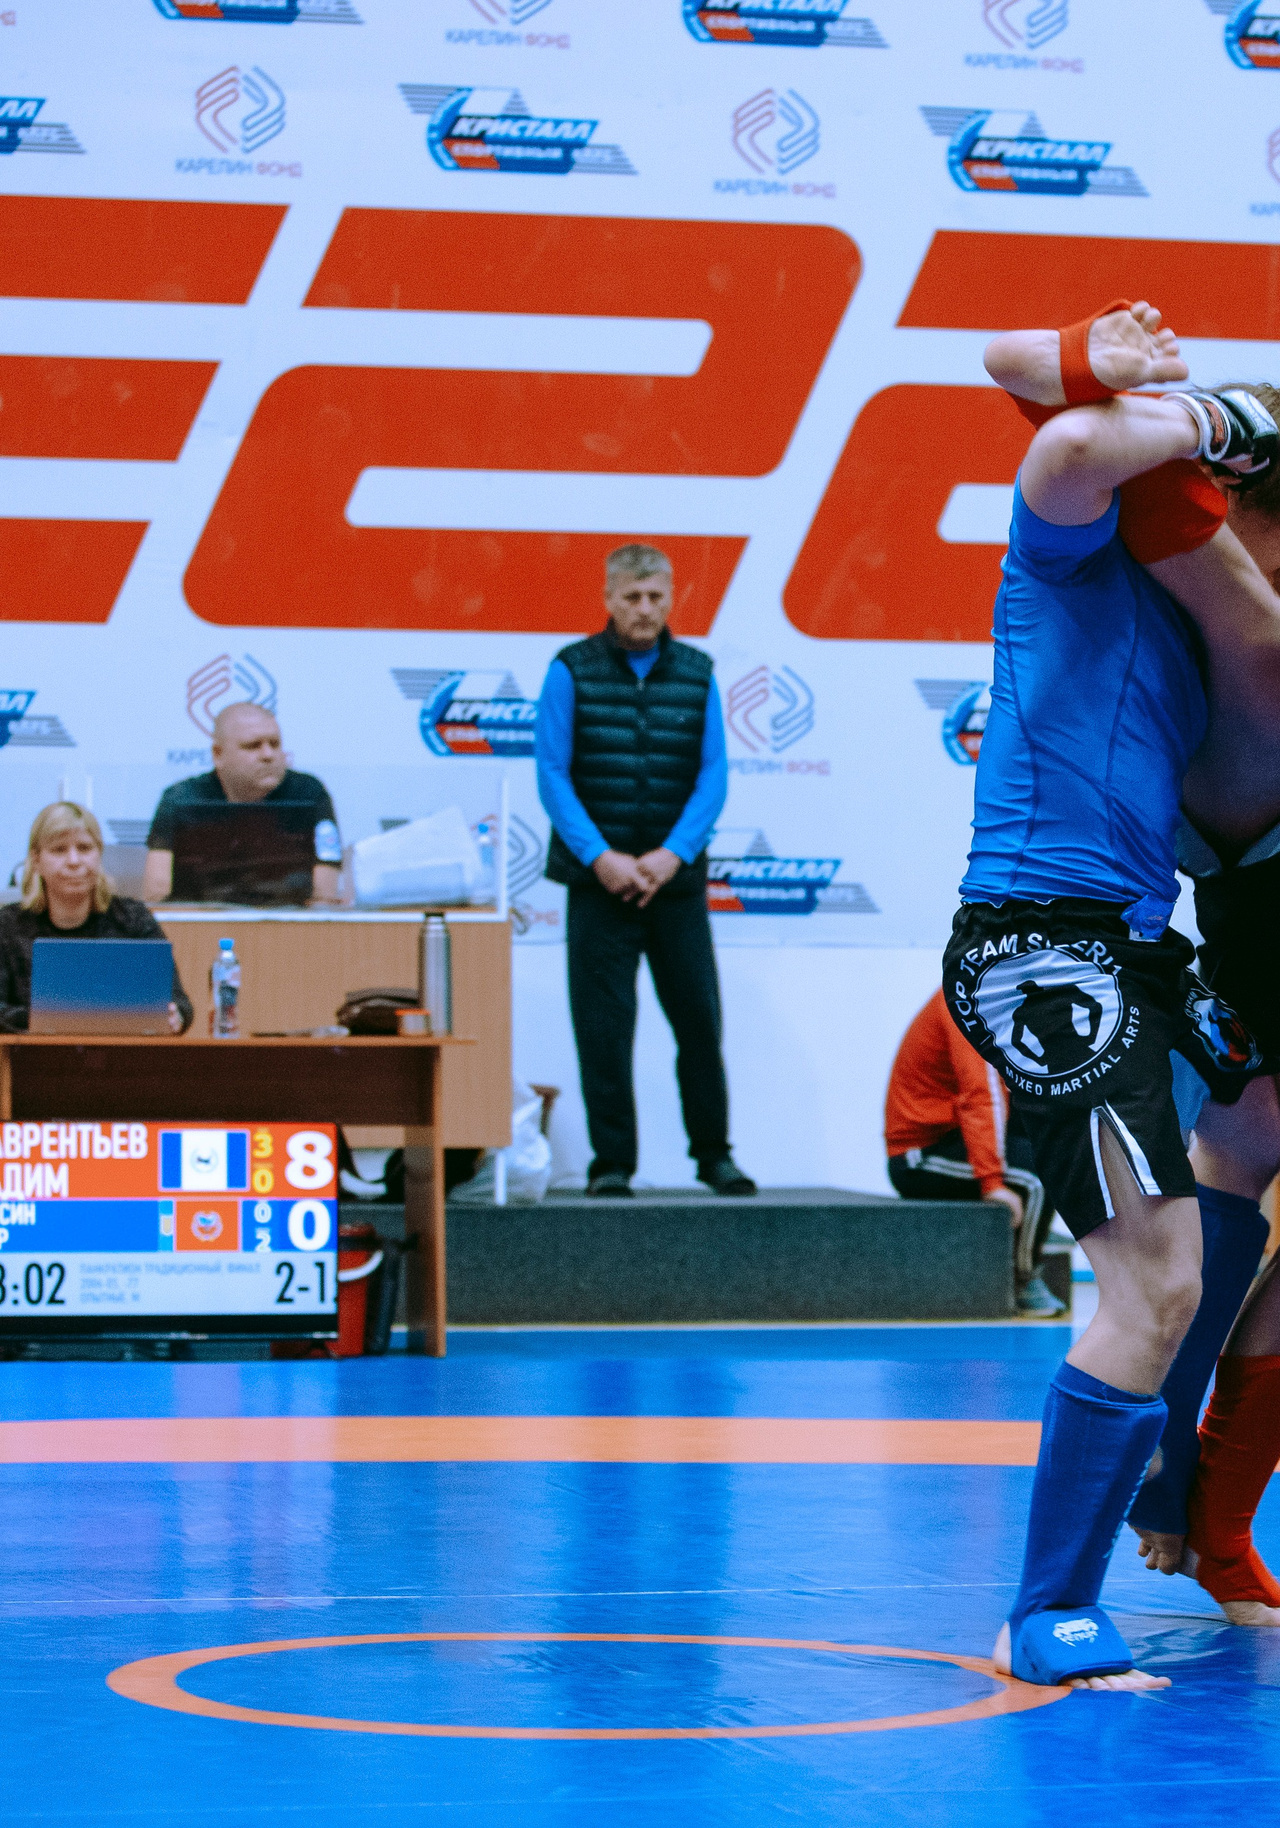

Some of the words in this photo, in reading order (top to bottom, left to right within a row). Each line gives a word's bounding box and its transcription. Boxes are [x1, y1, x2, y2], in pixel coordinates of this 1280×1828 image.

[450, 116, 593, 139] КРИСТАЛЛ
[970, 138, 1107, 162] КРИСТАЛЛ
[960, 934, 1018, 977] TEAM
[955, 981, 977, 1032] TOP
[1005, 1066, 1043, 1096] MIXED
[1050, 1054, 1121, 1096] MARTIAL
[1121, 1006, 1140, 1049] ARTS
[0, 1123, 148, 1159] ВРЕНТЬЕВ
[284, 1130, 335, 1190] 8
[0, 1162, 69, 1200] ДИМ
[287, 1199, 331, 1250] 0
